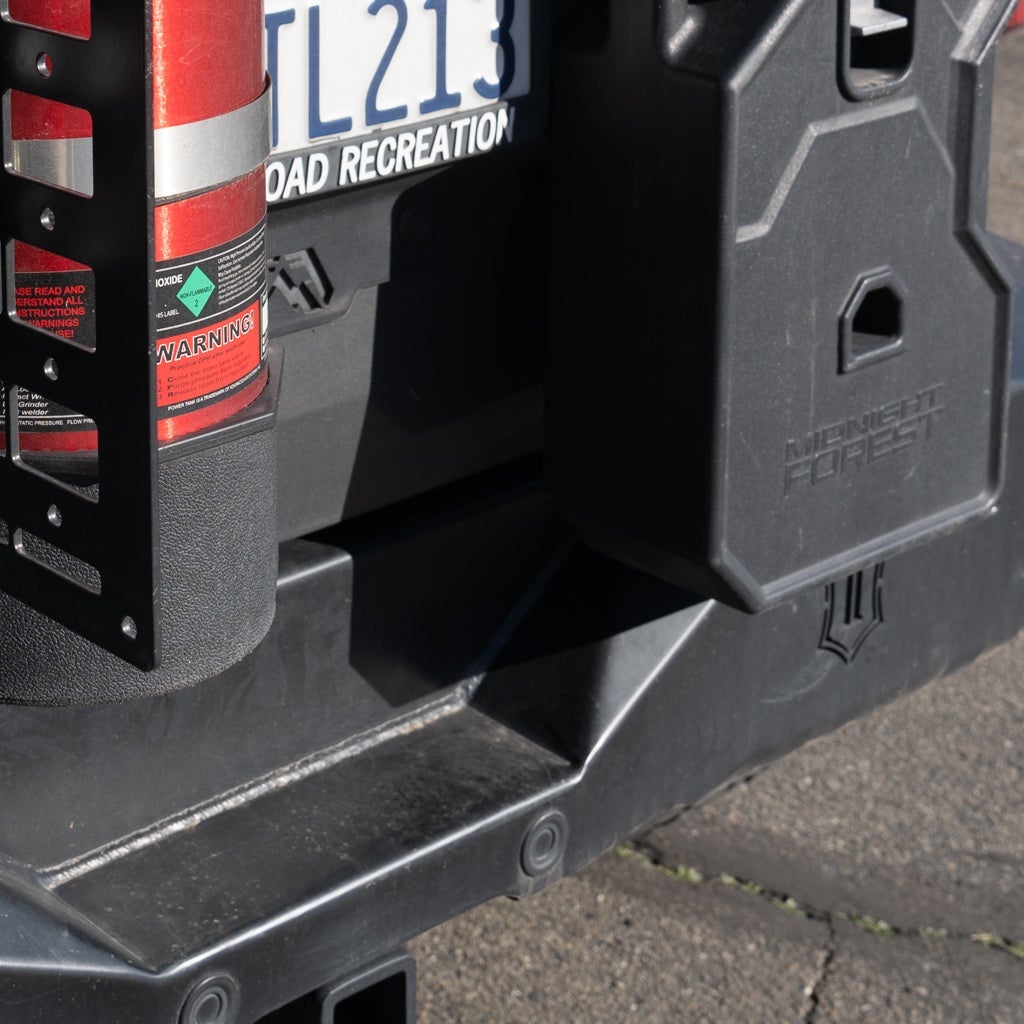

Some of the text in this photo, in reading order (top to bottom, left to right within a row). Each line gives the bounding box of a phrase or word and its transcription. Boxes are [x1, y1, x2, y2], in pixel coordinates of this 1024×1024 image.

[338, 106, 515, 187] RECREATION
[34, 286, 62, 296] READ
[64, 285, 86, 294] AND
[66, 295, 84, 305] ALL
[156, 309, 254, 365] WARNING!
[783, 404, 945, 499] FOREST
[785, 381, 945, 464] MIDNIGHT
